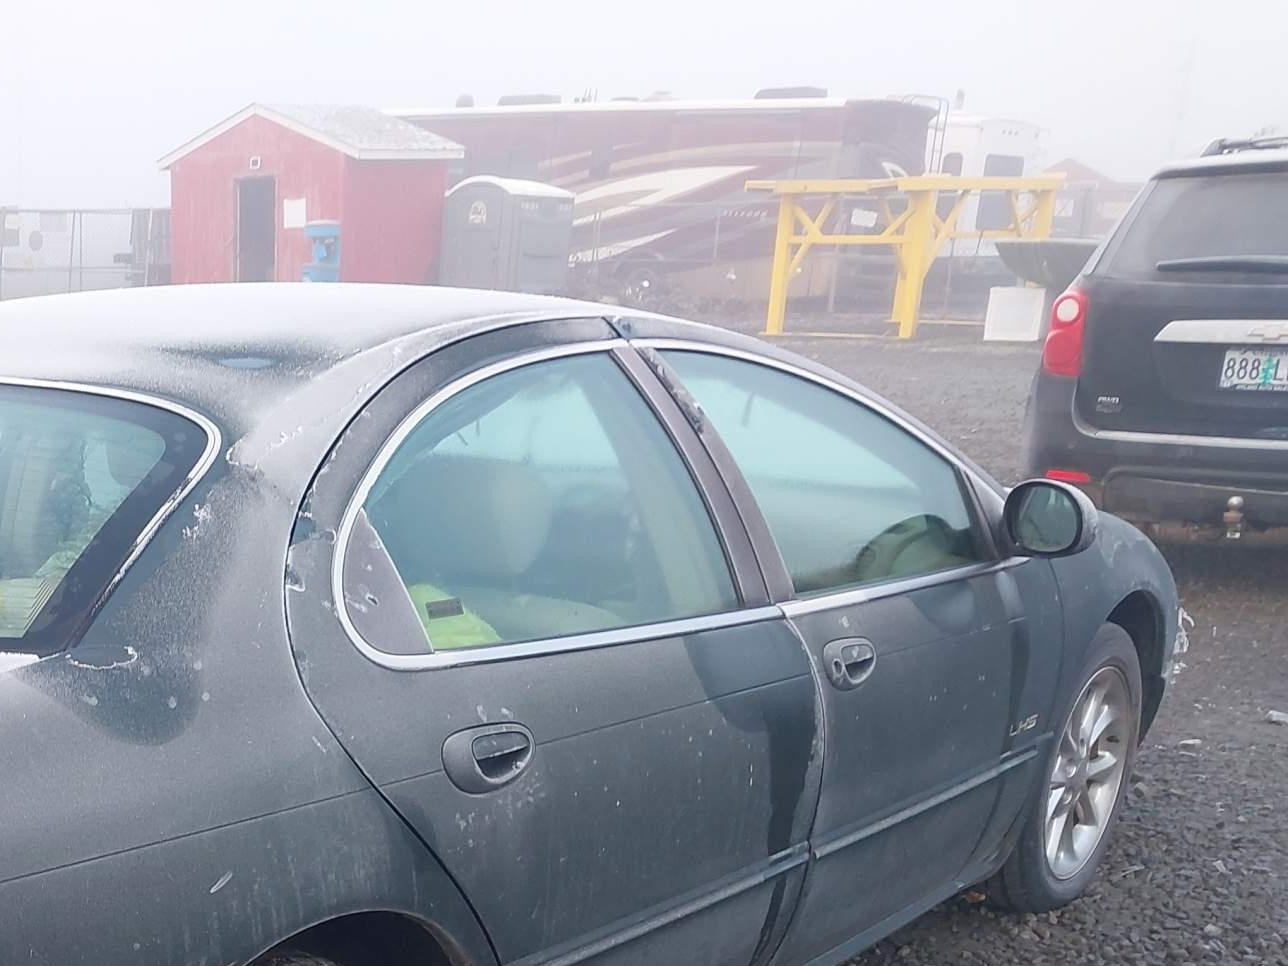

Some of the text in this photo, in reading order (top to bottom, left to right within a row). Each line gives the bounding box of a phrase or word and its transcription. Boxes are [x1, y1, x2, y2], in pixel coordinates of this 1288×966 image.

[1224, 357, 1288, 382] 888 L
[1009, 713, 1039, 737] LHS
